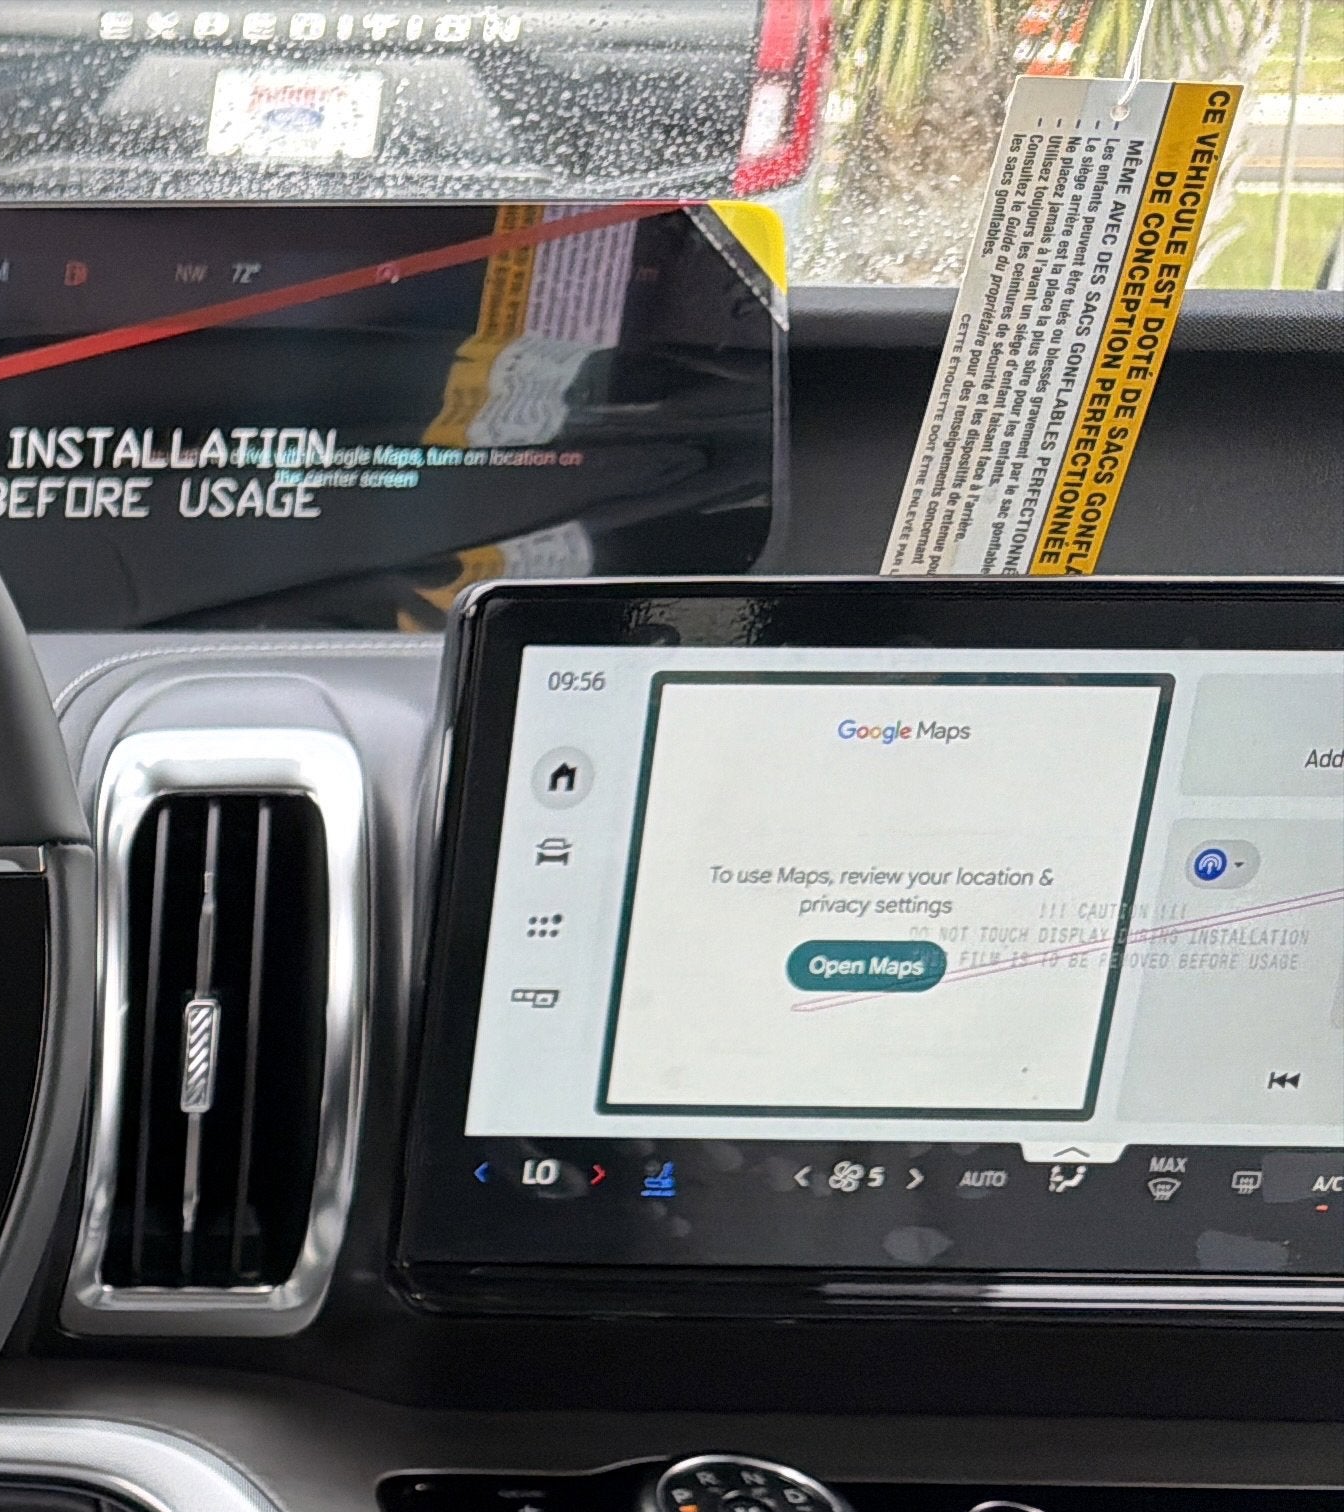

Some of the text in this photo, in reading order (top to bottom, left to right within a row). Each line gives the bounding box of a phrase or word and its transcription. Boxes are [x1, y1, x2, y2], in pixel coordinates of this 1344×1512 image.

[99, 8, 521, 42] EXPEDITION
[1201, 89, 1231, 124] CE
[1036, 134, 1064, 182] Utilisez
[1064, 135, 1082, 153] Ne
[1100, 137, 1121, 161] Les
[1051, 155, 1075, 199] placez
[1114, 139, 1145, 195] MÊME
[980, 132, 1027, 258] les sacs gonflables.
[1086, 163, 1110, 213] enfants
[1163, 131, 1220, 255] VÉHICULE
[1021, 184, 1049, 238] toujours
[1039, 199, 1065, 244] jamais
[1100, 199, 1127, 245] AVEC
[1015, 240, 1035, 260] les
[1036, 246, 1052, 255] à
[1070, 214, 1096, 267] peuvent
[1022, 258, 1049, 301] l'avant
[1063, 268, 1084, 296] être
[1089, 250, 1113, 285] DES
[999, 261, 1026, 320] ceintures
[1148, 262, 1182, 309] EST
[987, 136, 1102, 487] Le siège arrière est la place la plus sûre pour les enfants.
[1018, 303, 1033, 320] un
[1054, 297, 1075, 326] tués
[1074, 289, 1102, 337] SACS
[951, 312, 972, 353] CETTE
[994, 322, 1011, 339] de
[1049, 327, 1064, 344] ou
[910, 133, 1044, 565] Consultez le Guide du propriétaire pour des renseignements concernant
[1125, 316, 1166, 380] DOTÉ
[979, 340, 1004, 391] sécurité
[1034, 346, 1061, 393] blessés
[1037, 170, 1178, 564] DE CONCEPTION PERFECTIONNÉE
[974, 392, 989, 406] et
[992, 358, 1019, 409] d'enfant
[1039, 341, 1086, 451] GONFLABLES
[969, 407, 988, 426] les
[1112, 387, 1143, 419] DE
[979, 411, 1005, 453] faisant
[1014, 395, 1044, 459] gravement
[7, 427, 338, 469] INSTALLATION
[373, 446, 425, 468] Maps,
[426, 447, 462, 467] turn
[489, 450, 557, 467] location
[950, 427, 981, 489] dispositifs
[1092, 425, 1129, 484] SACS
[971, 454, 992, 481] face
[1008, 461, 1024, 482] par
[178, 476, 322, 518] USAGE
[945, 490, 962, 507] de
[968, 482, 984, 492] à
[1003, 483, 1020, 496] le
[996, 497, 1013, 519] sac
[932, 507, 955, 553] retenue
[891, 542, 908, 566] PAR
[547, 671, 606, 692] 09:56
[837, 719, 971, 745] Google Maps
[710, 866, 1055, 889] To use Maps, review your location &
[798, 895, 953, 918] privacy settings
[1189, 929, 1312, 946] INSTALLATION
[808, 955, 925, 980] Open Maps
[1178, 953, 1240, 970] BEFORE
[1249, 953, 1300, 971] USAGE
[521, 1158, 559, 1186] LO
[867, 1166, 886, 1187] 5
[959, 1170, 1008, 1188] AUTO
[1149, 1156, 1188, 1174] MAX
[1313, 1176, 1344, 1193] A/C
